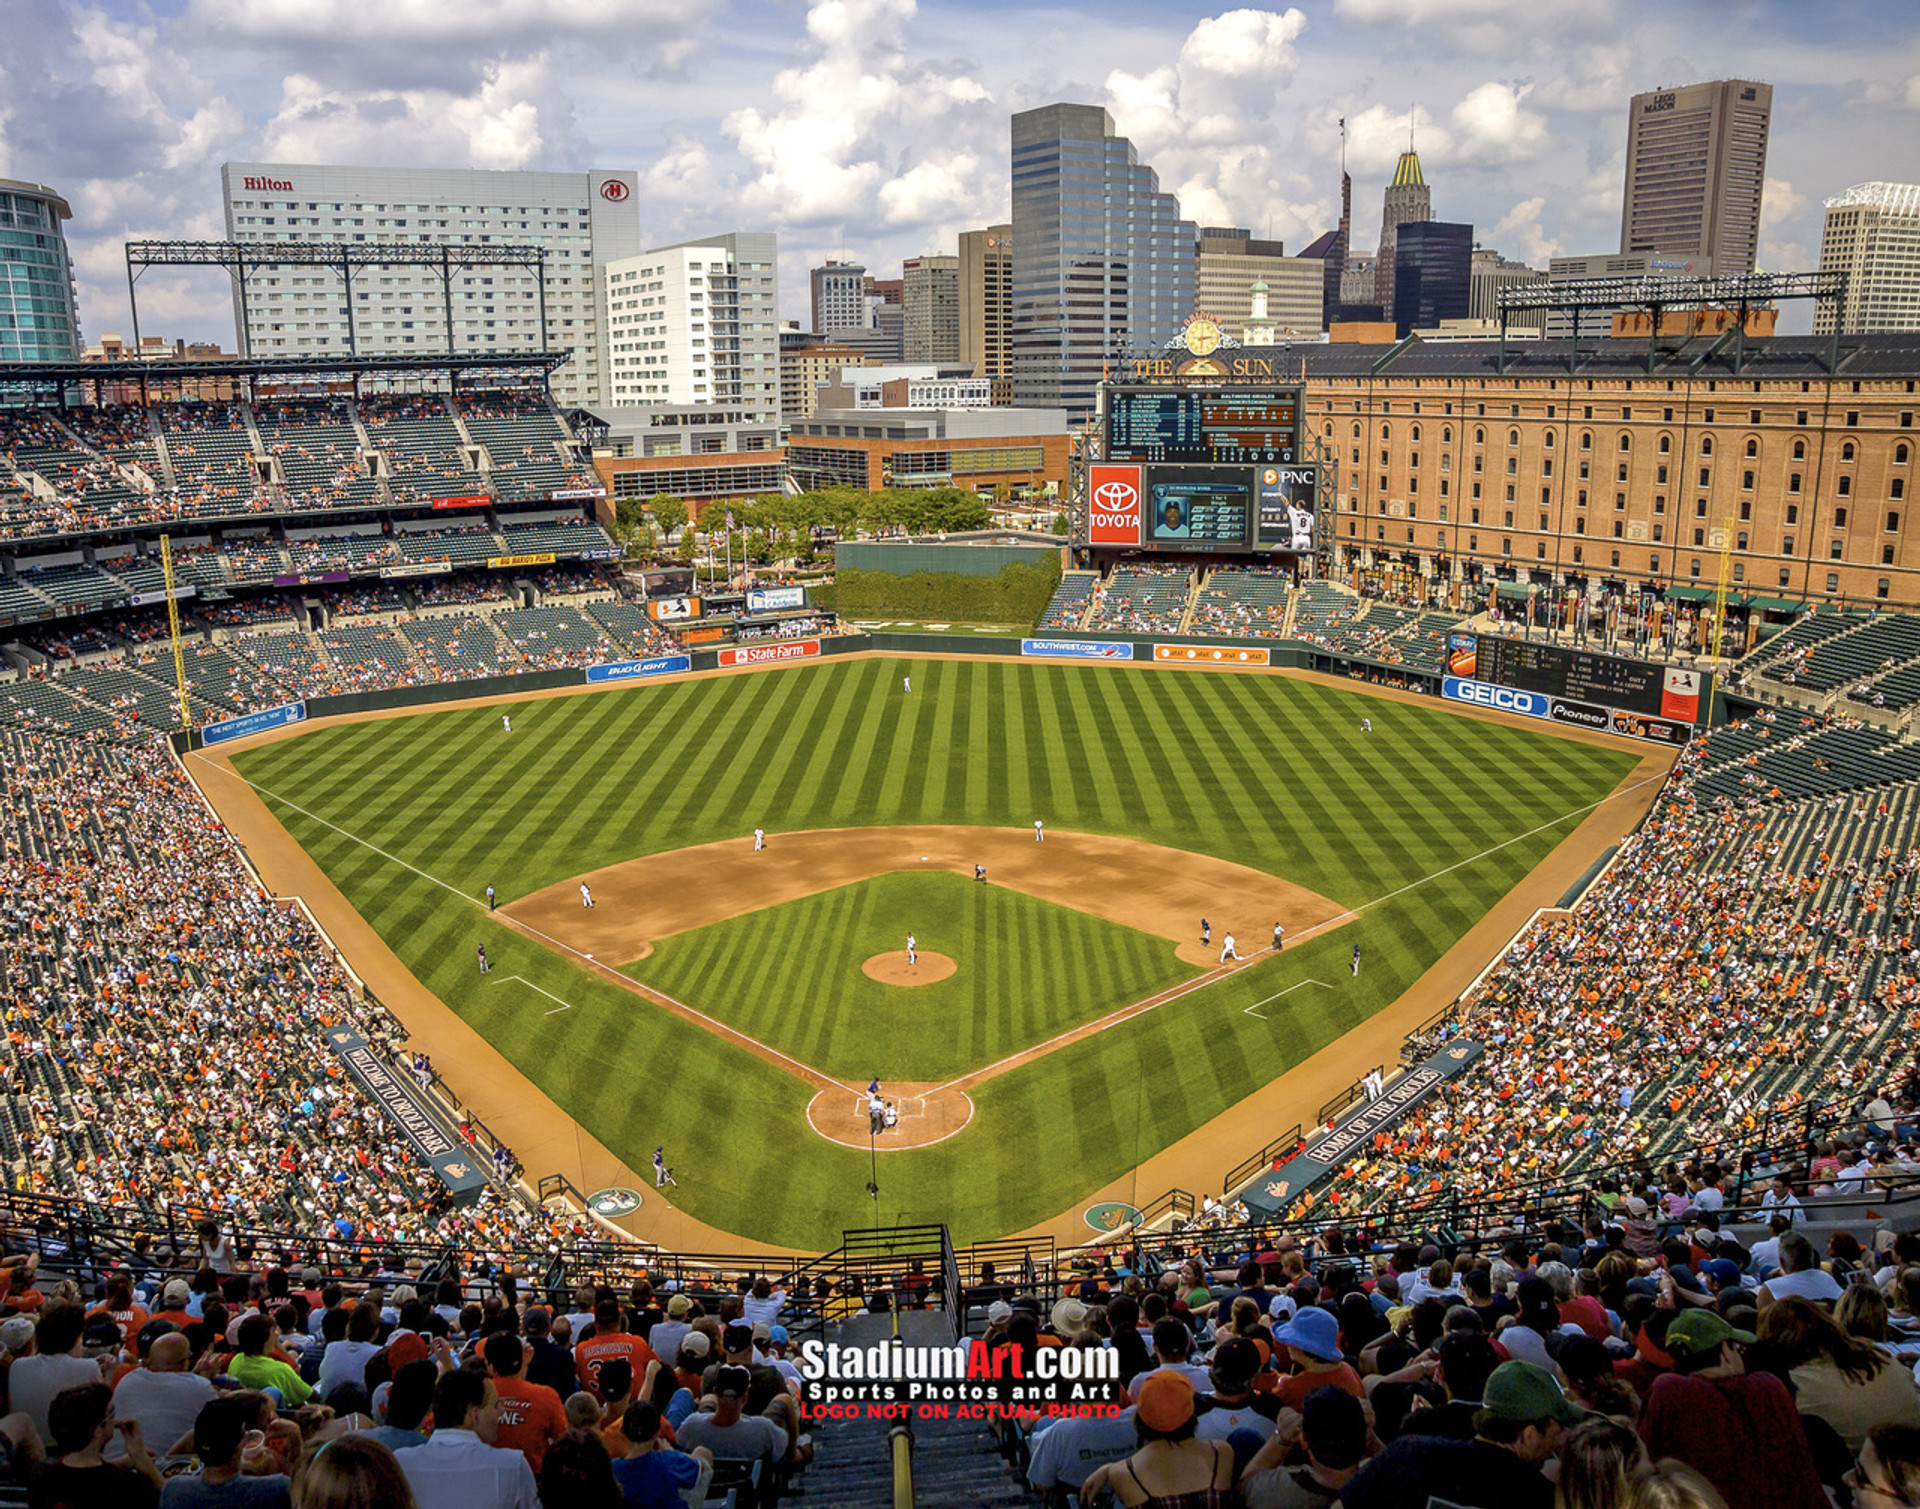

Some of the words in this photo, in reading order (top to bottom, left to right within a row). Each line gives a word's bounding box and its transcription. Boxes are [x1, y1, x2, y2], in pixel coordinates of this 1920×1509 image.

[1654, 93, 1675, 103] LEGG
[1644, 101, 1675, 113] MASON
[243, 175, 293, 191] Hilton
[1132, 359, 1173, 377] THE
[1233, 359, 1273, 377] SUN
[1267, 452, 1274, 461] 0
[1283, 452, 1291, 461] 0
[1280, 471, 1314, 484] PNC
[1090, 514, 1140, 527] TOYOTA
[1300, 518, 1307, 527] 8
[749, 647, 777, 661] State
[777, 644, 804, 657] Farm
[1033, 642, 1097, 651] SOUTHWEST.COM
[608, 666, 634, 675] BUD
[1458, 682, 1532, 712] GEICO
[1553, 705, 1606, 723] Pioneer
[350, 1048, 390, 1087] WELCOME
[380, 1084, 400, 1100] TO
[390, 1096, 425, 1131] ORIOLE
[415, 1126, 450, 1154] PARK
[1310, 1132, 1357, 1161] HOME
[1348, 1118, 1371, 1134] OF
[1363, 1100, 1397, 1122] THE
[1388, 1069, 1439, 1104] ORIOLES
